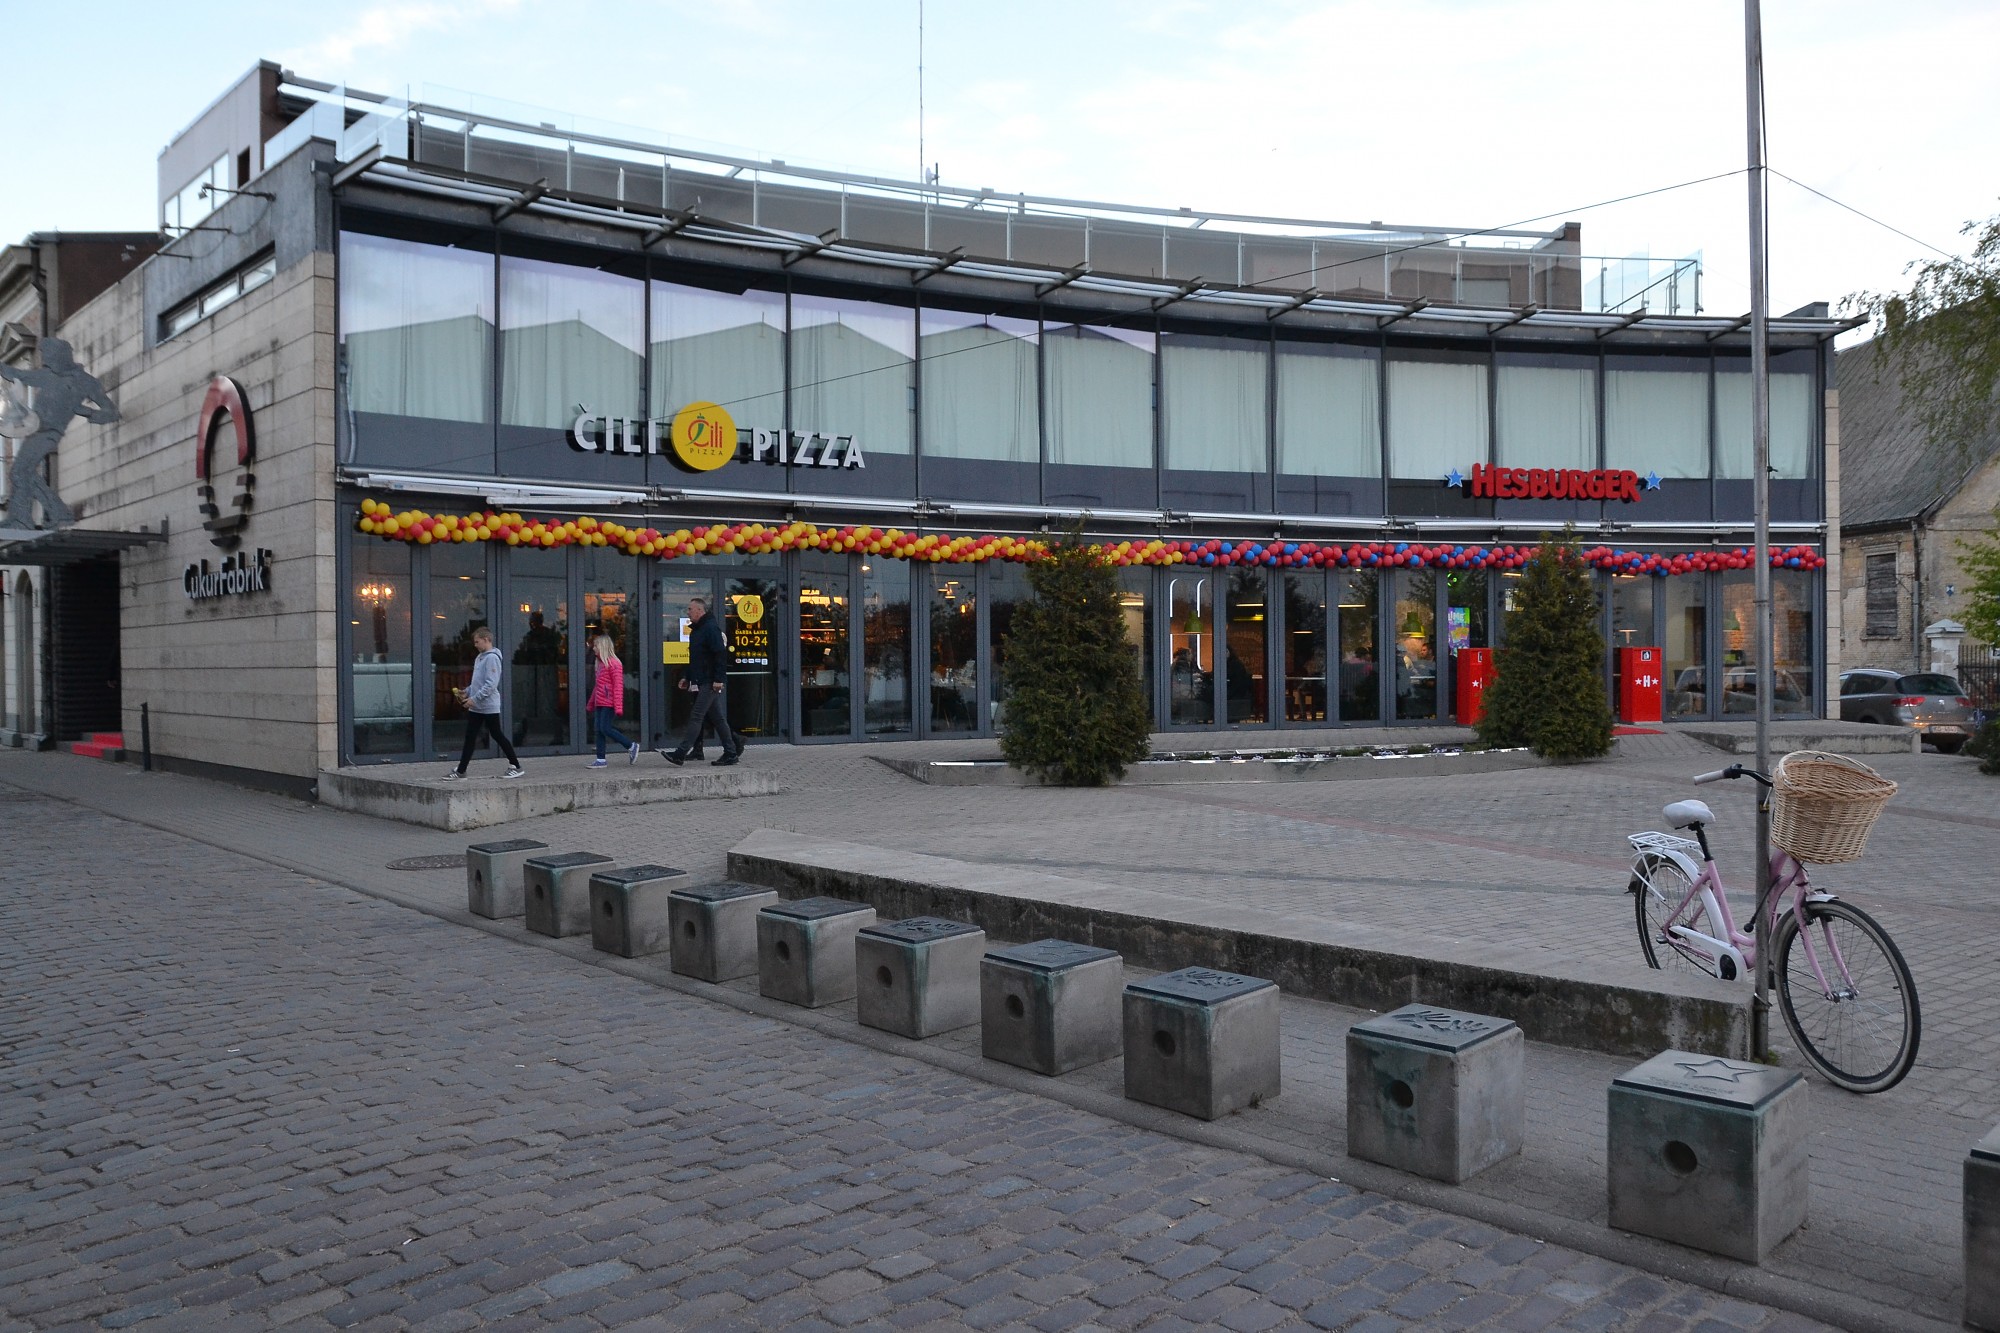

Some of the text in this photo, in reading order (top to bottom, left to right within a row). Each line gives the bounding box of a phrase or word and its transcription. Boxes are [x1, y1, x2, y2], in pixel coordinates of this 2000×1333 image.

[571, 403, 866, 469] ČILI PIZZA
[690, 447, 723, 457] PIZZA
[1471, 463, 1642, 502] HESBURGER
[735, 636, 768, 646] 10-24
